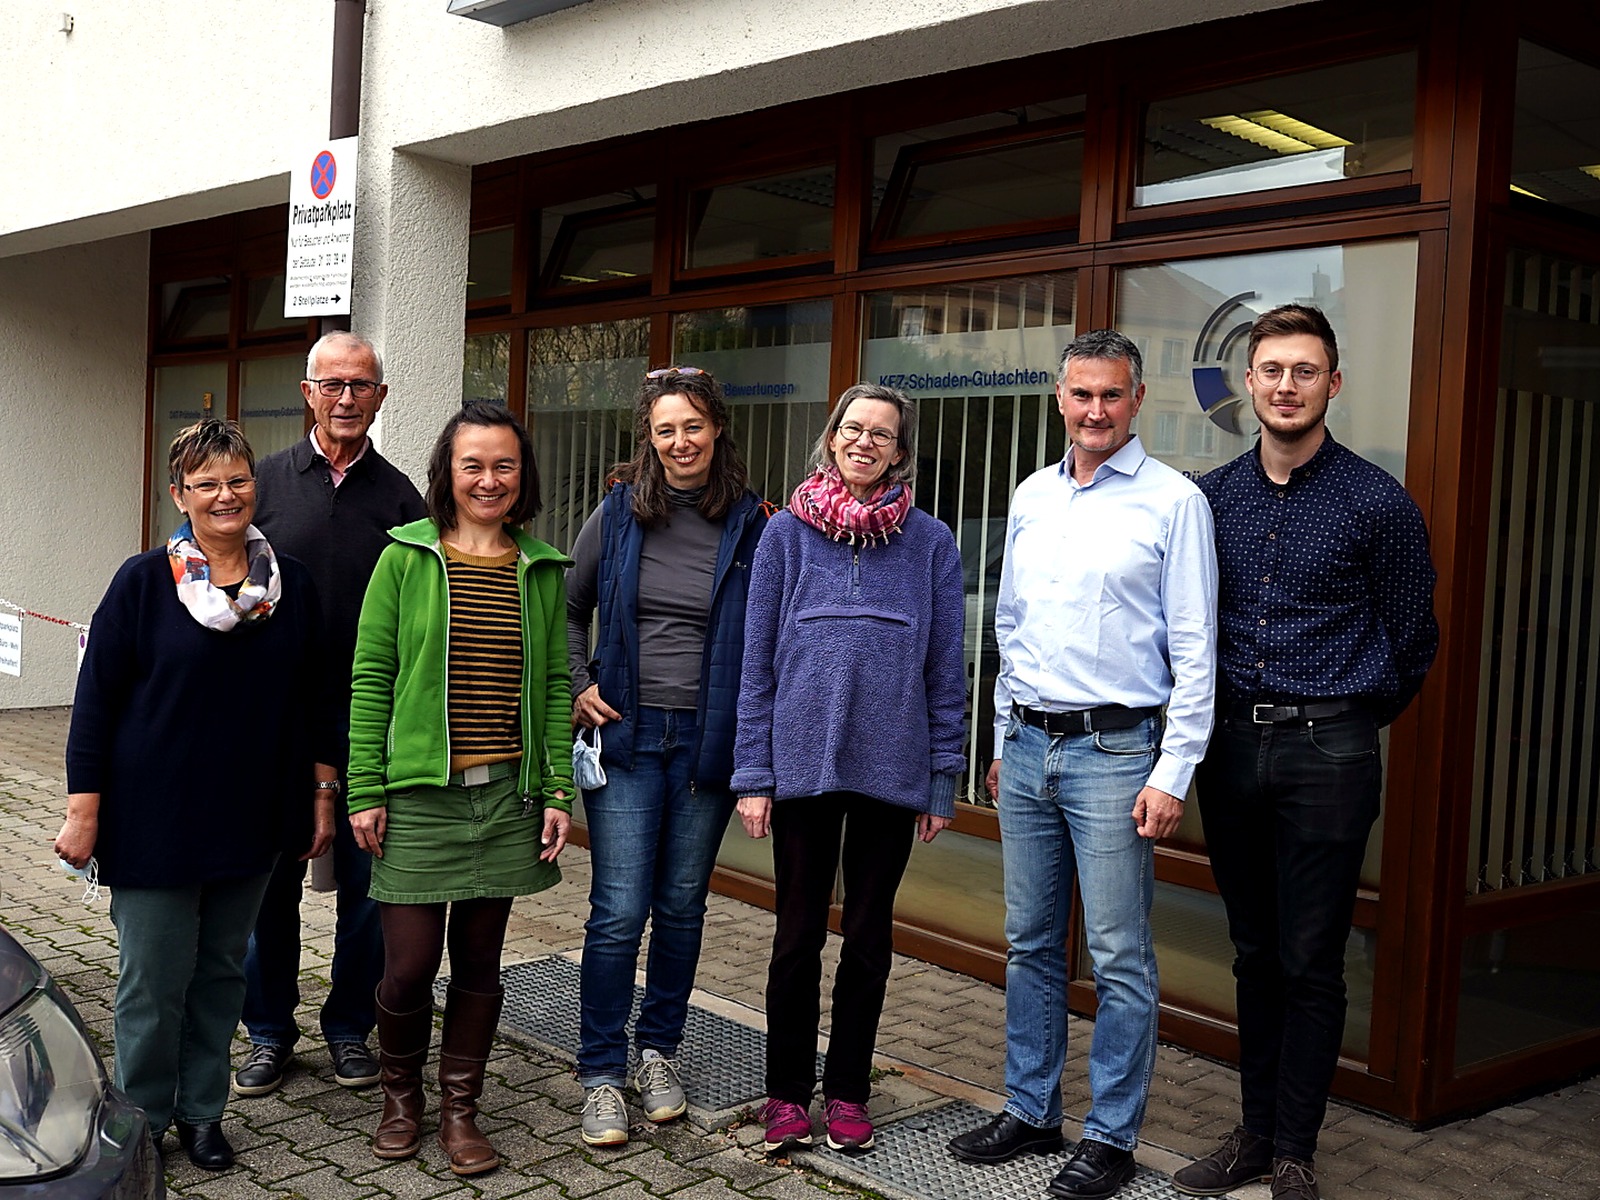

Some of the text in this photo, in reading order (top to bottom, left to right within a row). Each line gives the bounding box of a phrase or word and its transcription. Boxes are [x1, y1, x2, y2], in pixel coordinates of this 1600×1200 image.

[292, 199, 351, 228] Privatparkplatz
[293, 296, 297, 306] 2
[879, 368, 1048, 390] KFZ-Schaden-Gutachten
[724, 382, 795, 398] Bewertungen
